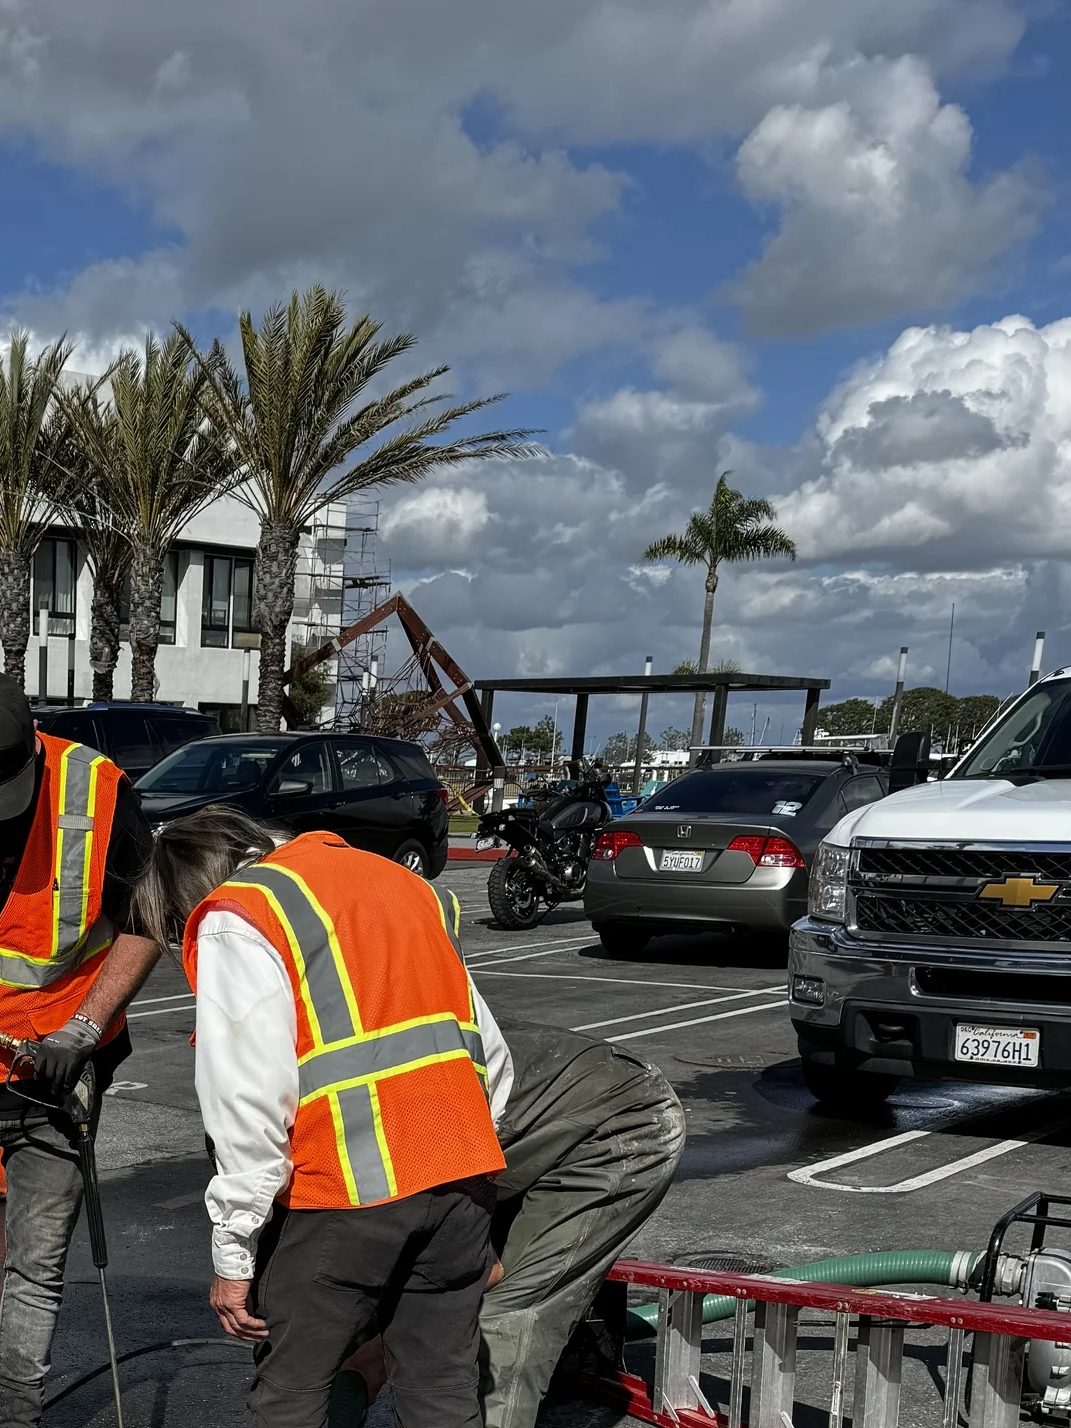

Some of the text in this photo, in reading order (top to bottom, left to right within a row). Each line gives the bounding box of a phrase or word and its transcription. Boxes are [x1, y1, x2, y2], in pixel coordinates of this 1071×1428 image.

[772, 800, 803, 817] 12
[663, 855, 701, 869] 5YUF017
[972, 1027, 1019, 1039] California
[960, 1038, 1032, 1061] 63976H1
